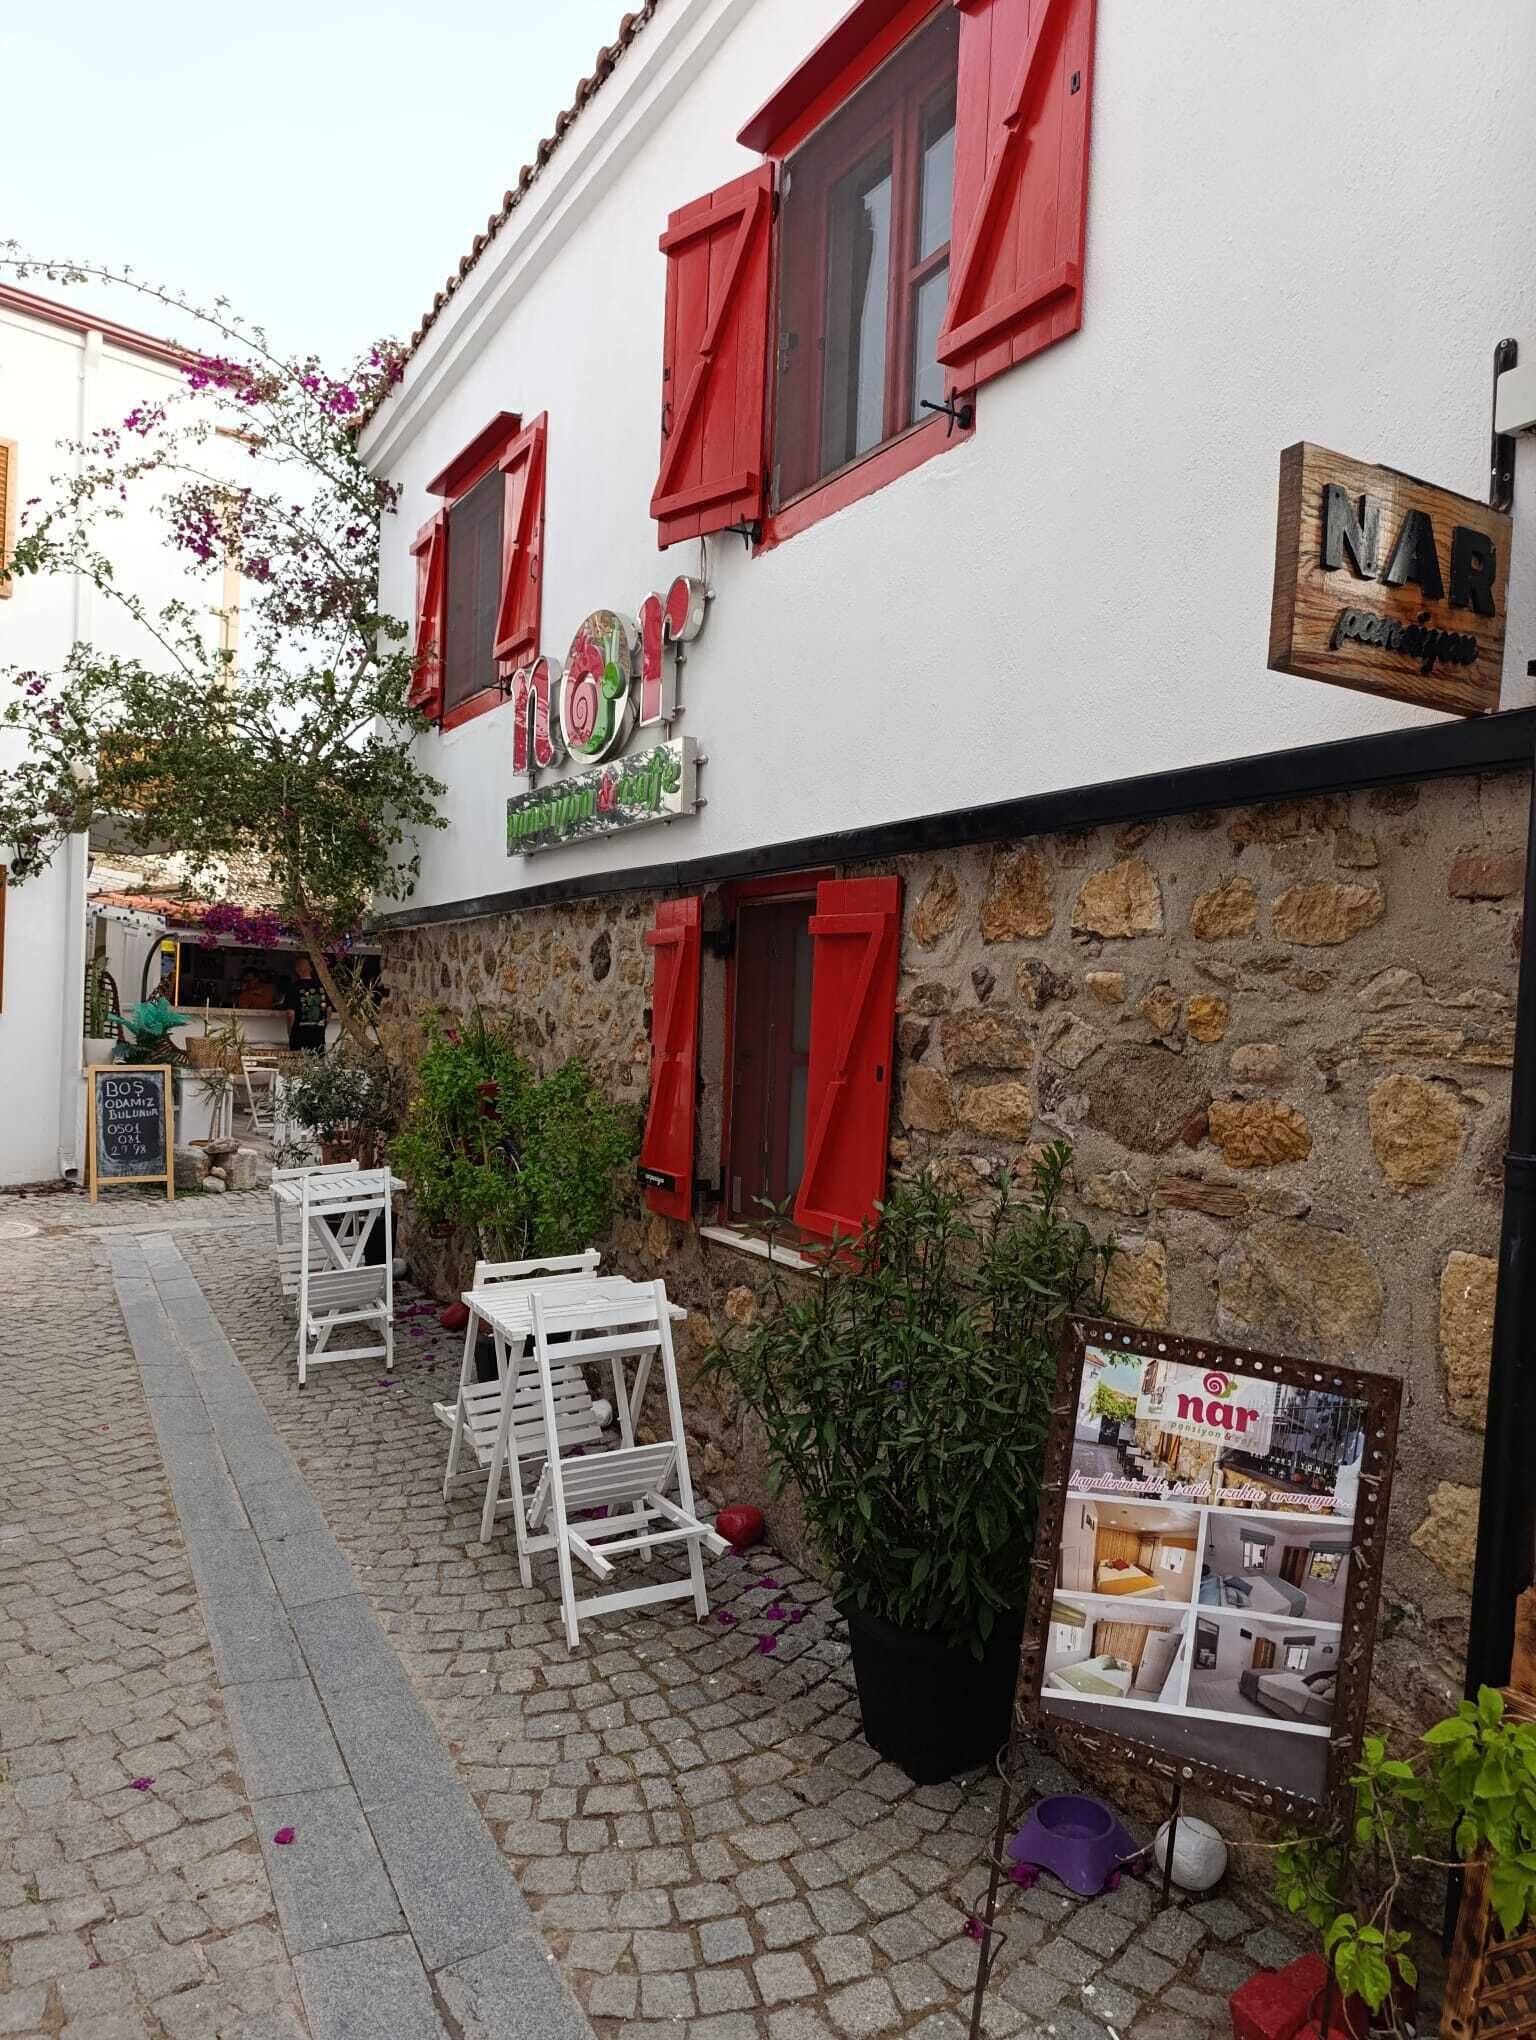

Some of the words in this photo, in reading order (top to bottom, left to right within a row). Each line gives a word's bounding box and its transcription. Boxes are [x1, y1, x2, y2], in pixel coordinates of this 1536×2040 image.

[1320, 483, 1497, 618] NAR
[106, 1081, 145, 1097] BOŞ
[104, 1097, 155, 1109] ODAMIZ
[1176, 1393, 1260, 1432] nar
[1170, 1421, 1221, 1438] pansiyon
